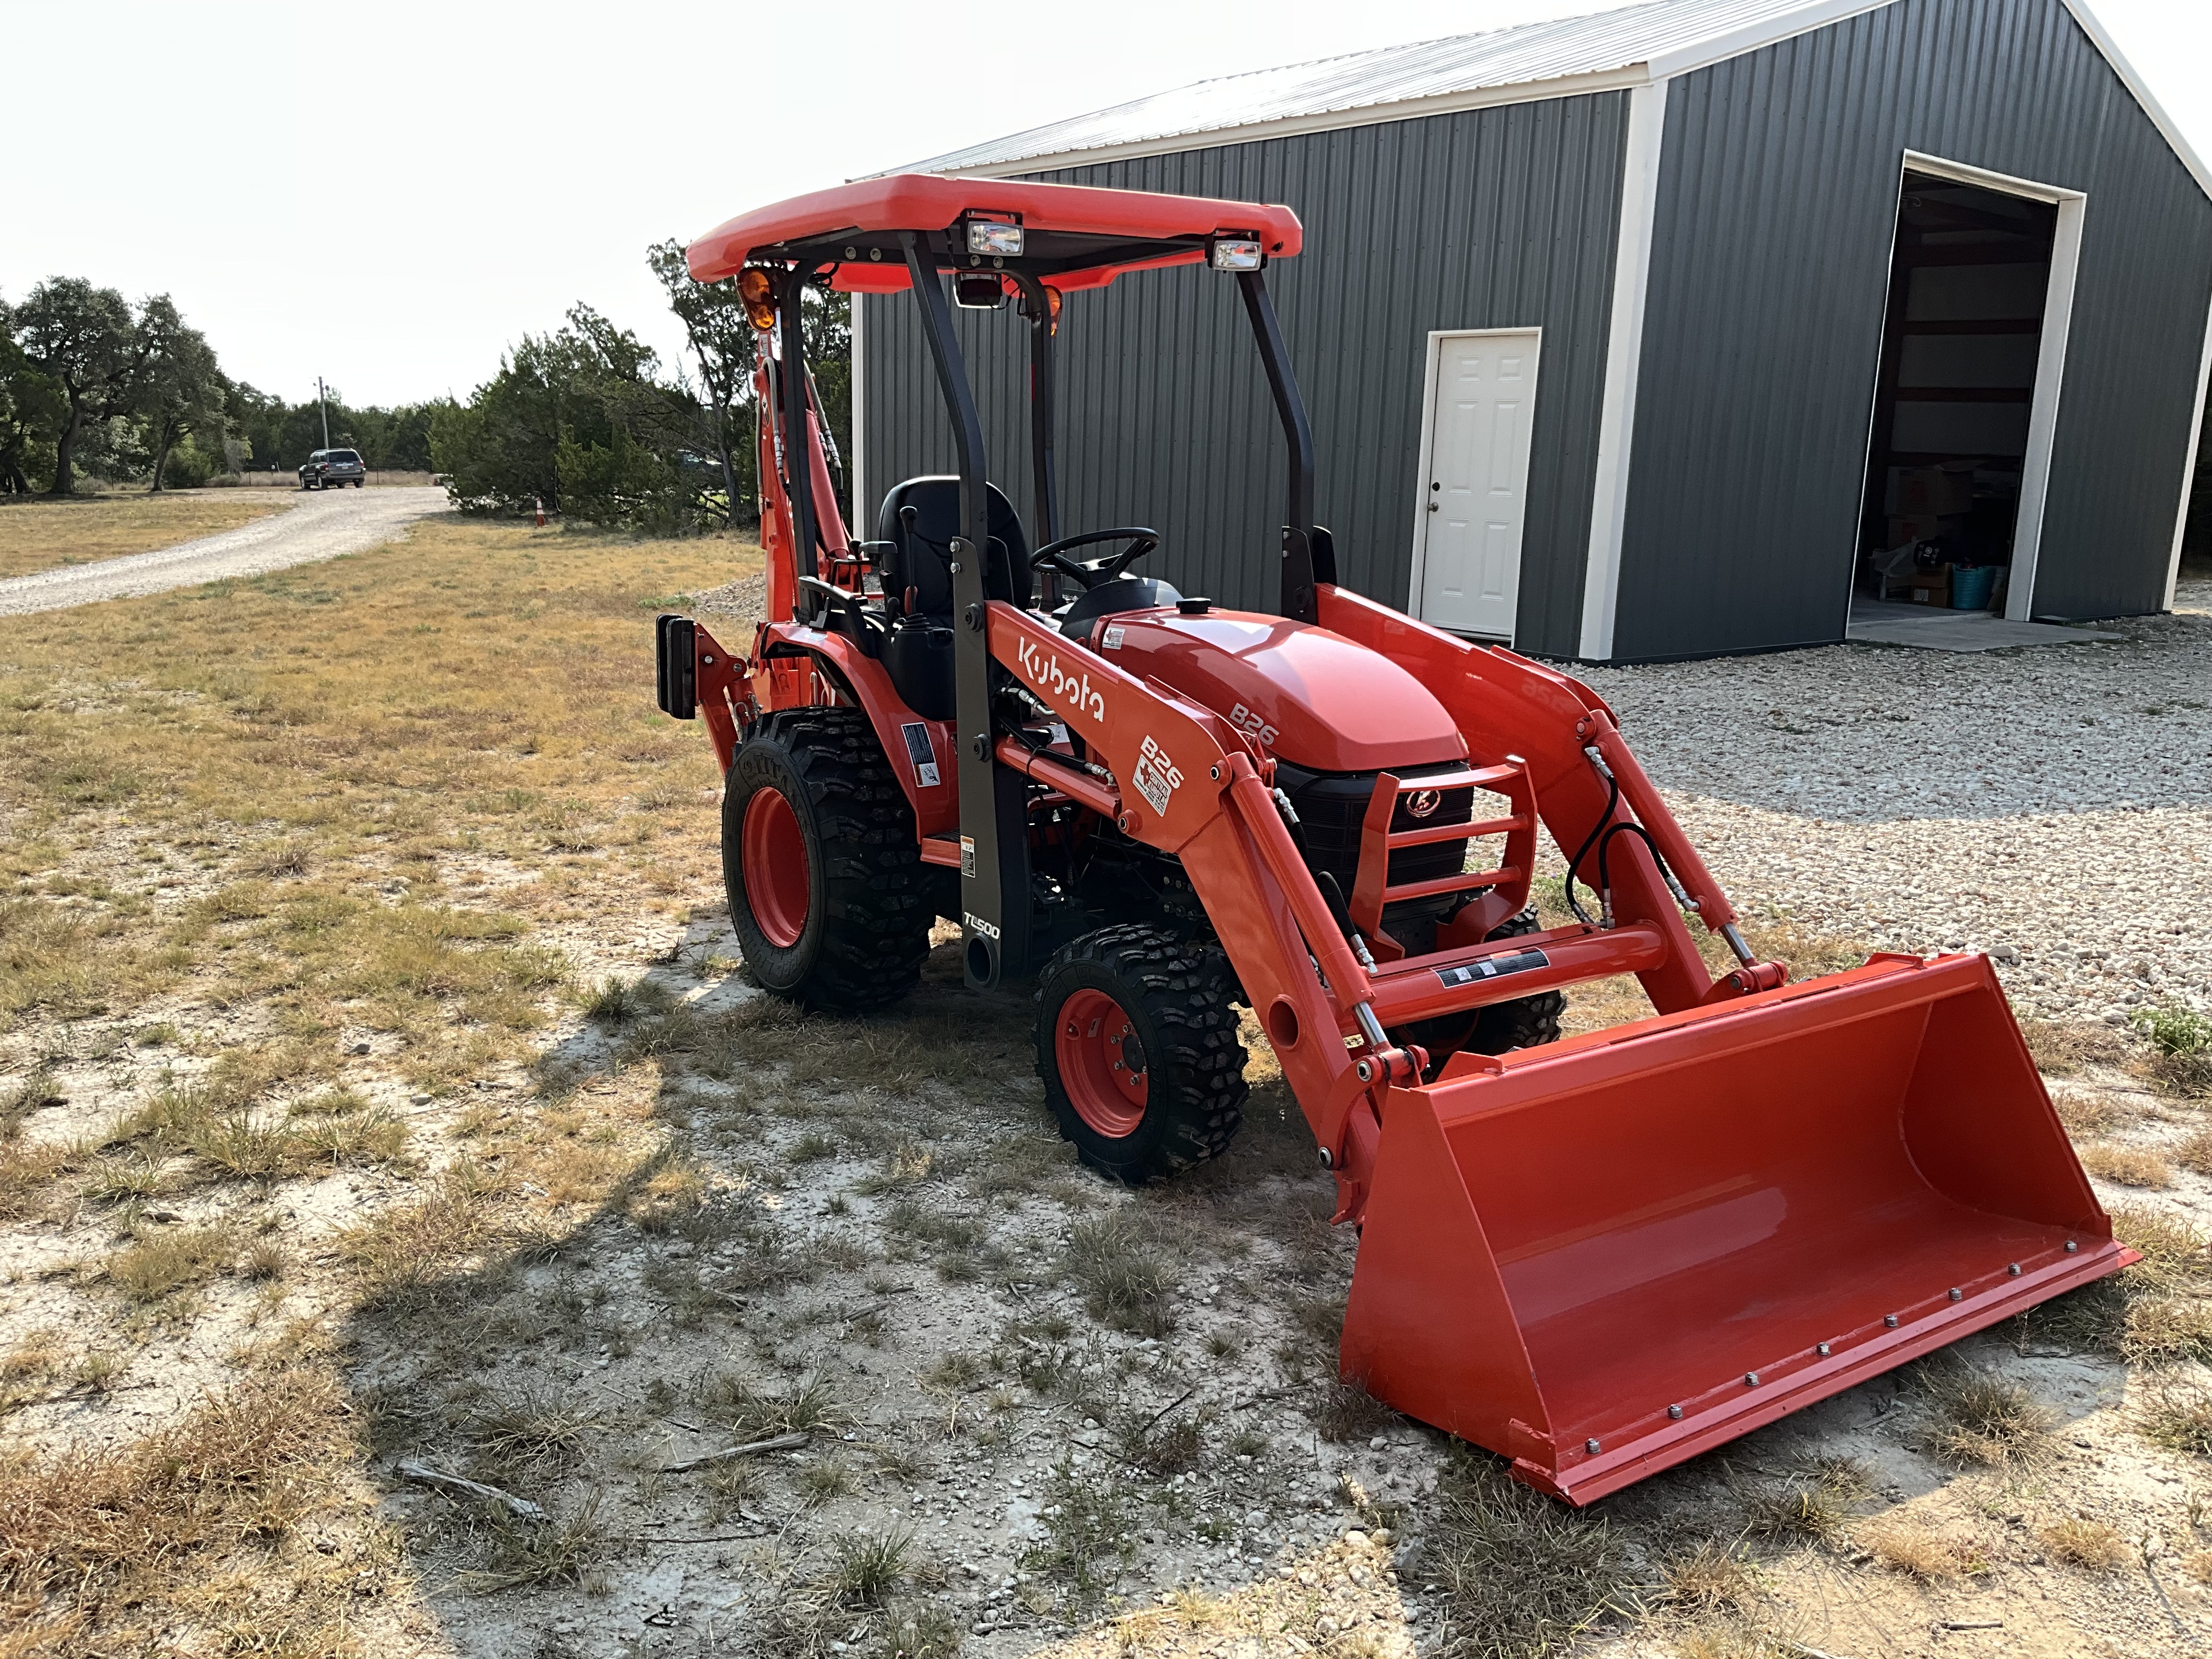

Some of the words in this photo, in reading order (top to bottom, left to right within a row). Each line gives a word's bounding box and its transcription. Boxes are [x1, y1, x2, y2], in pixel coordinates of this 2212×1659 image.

[1018, 636, 1105, 723] Kubota
[1229, 702, 1280, 746] B26
[1141, 735, 1184, 788] B26
[1147, 780, 1166, 806] KUBOTA
[1149, 772, 1168, 798] CENTRAL
[964, 911, 1000, 940] TL500
